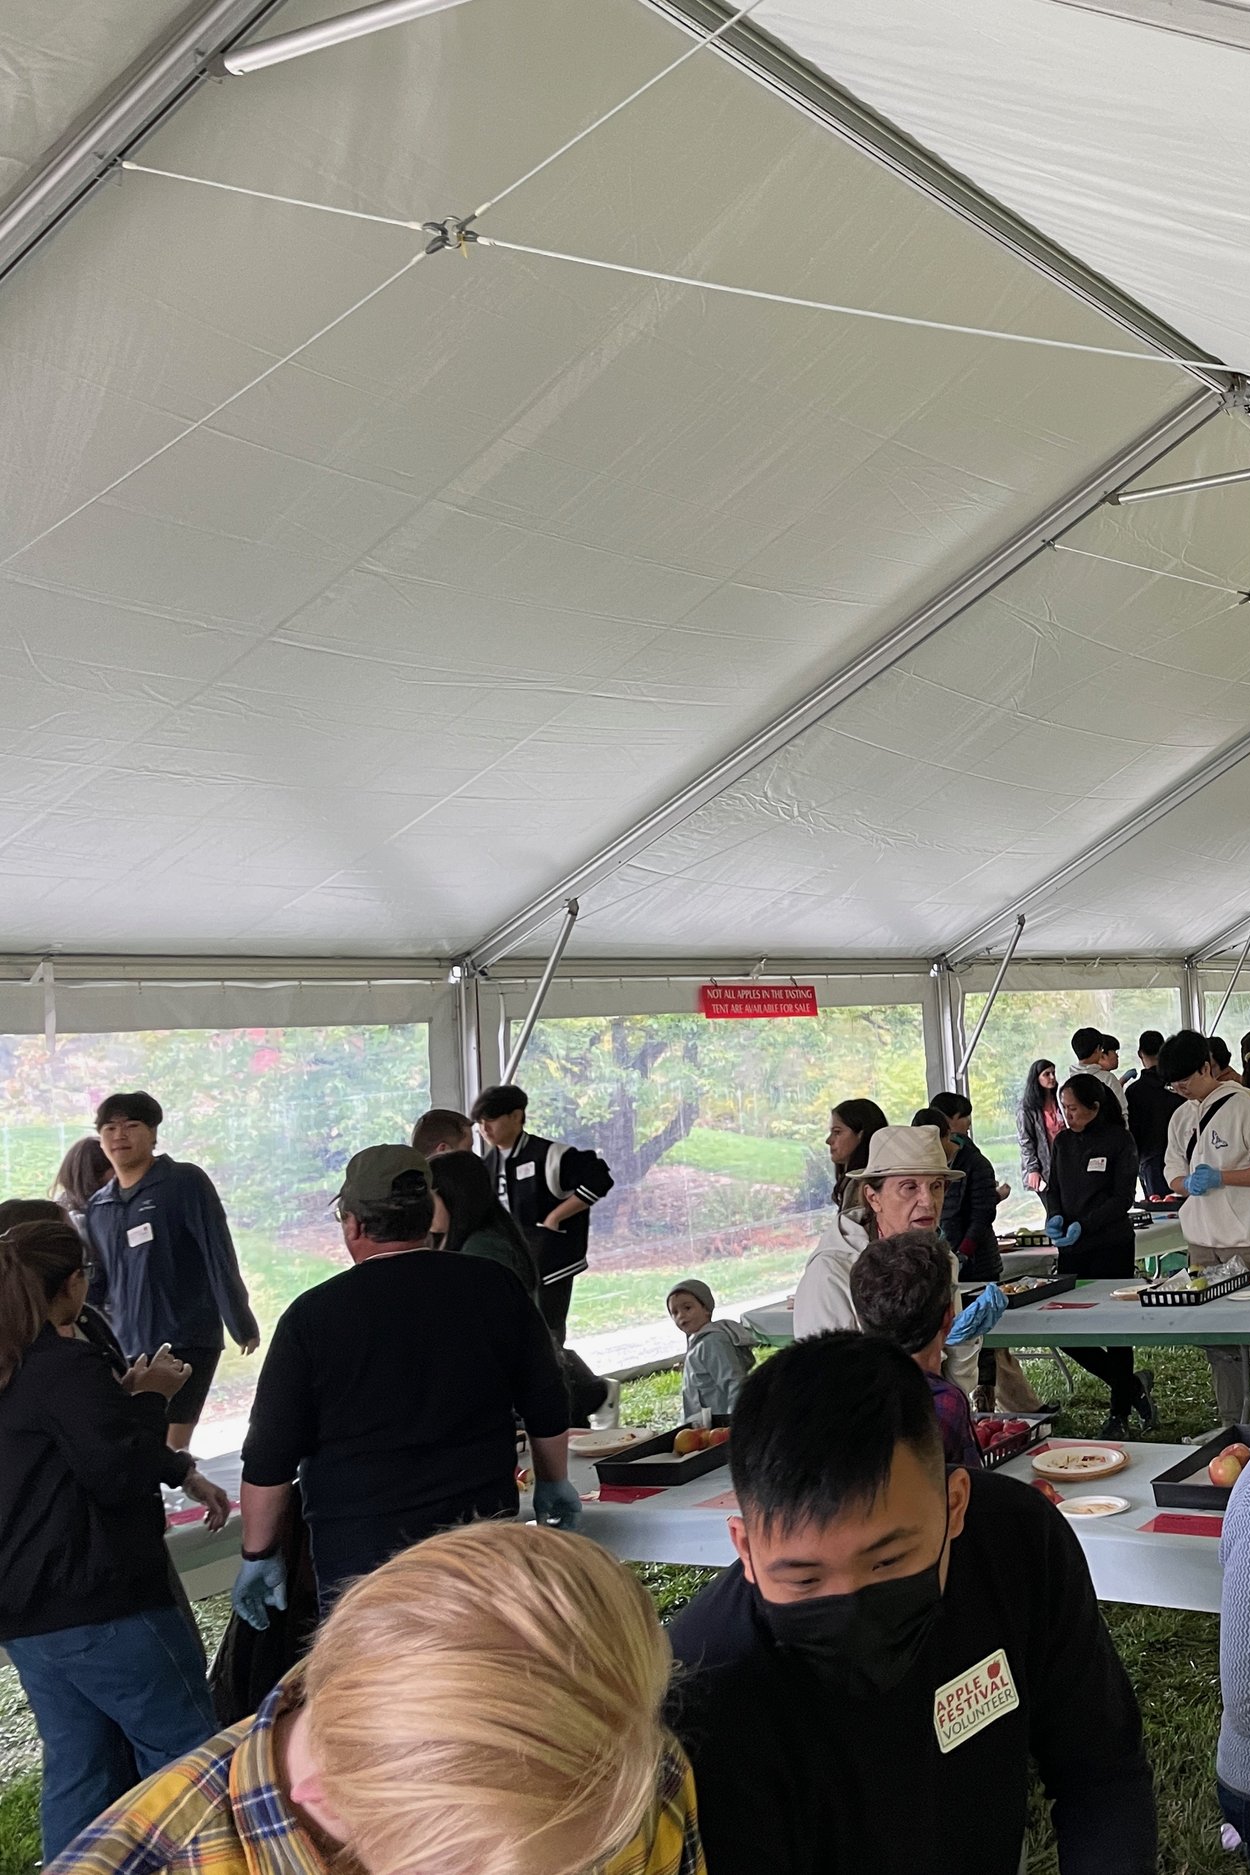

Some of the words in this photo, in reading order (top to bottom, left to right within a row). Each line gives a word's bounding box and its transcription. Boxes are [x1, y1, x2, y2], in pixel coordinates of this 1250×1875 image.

[706, 988, 722, 999] NOT
[723, 988, 736, 999] ALL
[736, 988, 761, 999] APPLES
[761, 988, 770, 999] IN
[771, 988, 784, 999] THE
[784, 988, 812, 999] TASTING
[711, 1003, 729, 1014] TENT
[730, 1003, 743, 1014] ARE
[744, 1003, 779, 1014] AVAILABLE
[780, 1003, 794, 1013] FOR
[794, 1002, 811, 1013] SALE
[936, 1675, 982, 1716] APPLE
[938, 1676, 1009, 1729] FESTIVAL
[942, 1688, 1015, 1740] VOLUNTEER
